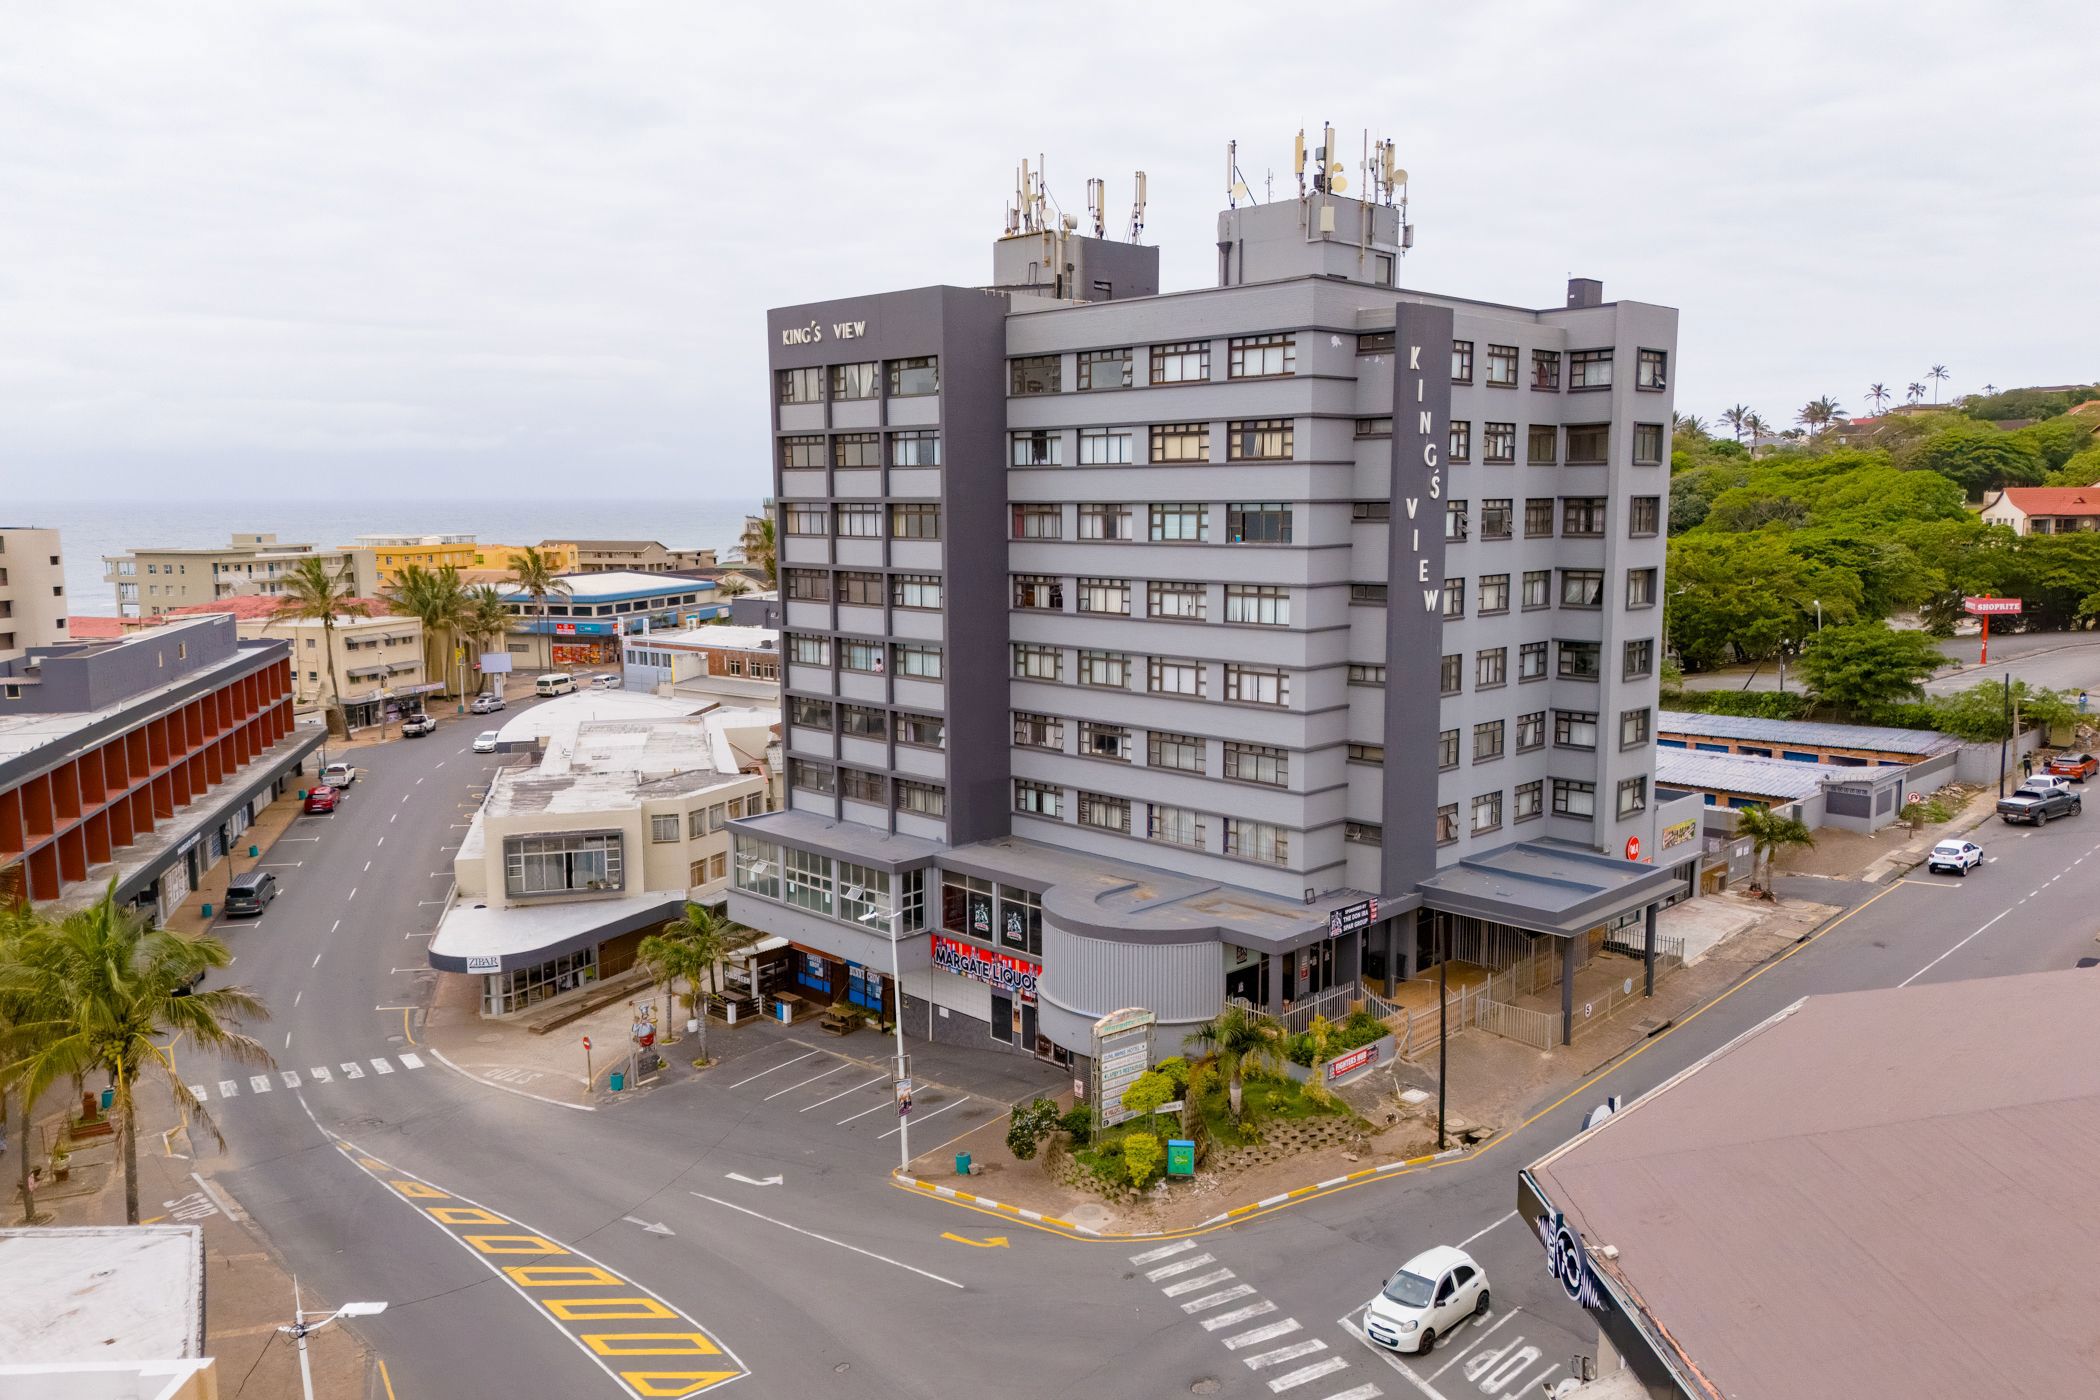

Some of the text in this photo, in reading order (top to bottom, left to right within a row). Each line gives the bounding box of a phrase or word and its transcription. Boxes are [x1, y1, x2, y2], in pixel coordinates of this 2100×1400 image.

[782, 320, 866, 345] KING'S VIEW
[1406, 498, 1439, 612] VIEW
[1977, 603, 2020, 611] SHOPRITE
[1343, 915, 1351, 923] THE
[1343, 923, 1354, 932] SPAR
[935, 947, 992, 979] MARGATE
[162, 1192, 219, 1222] STOP
